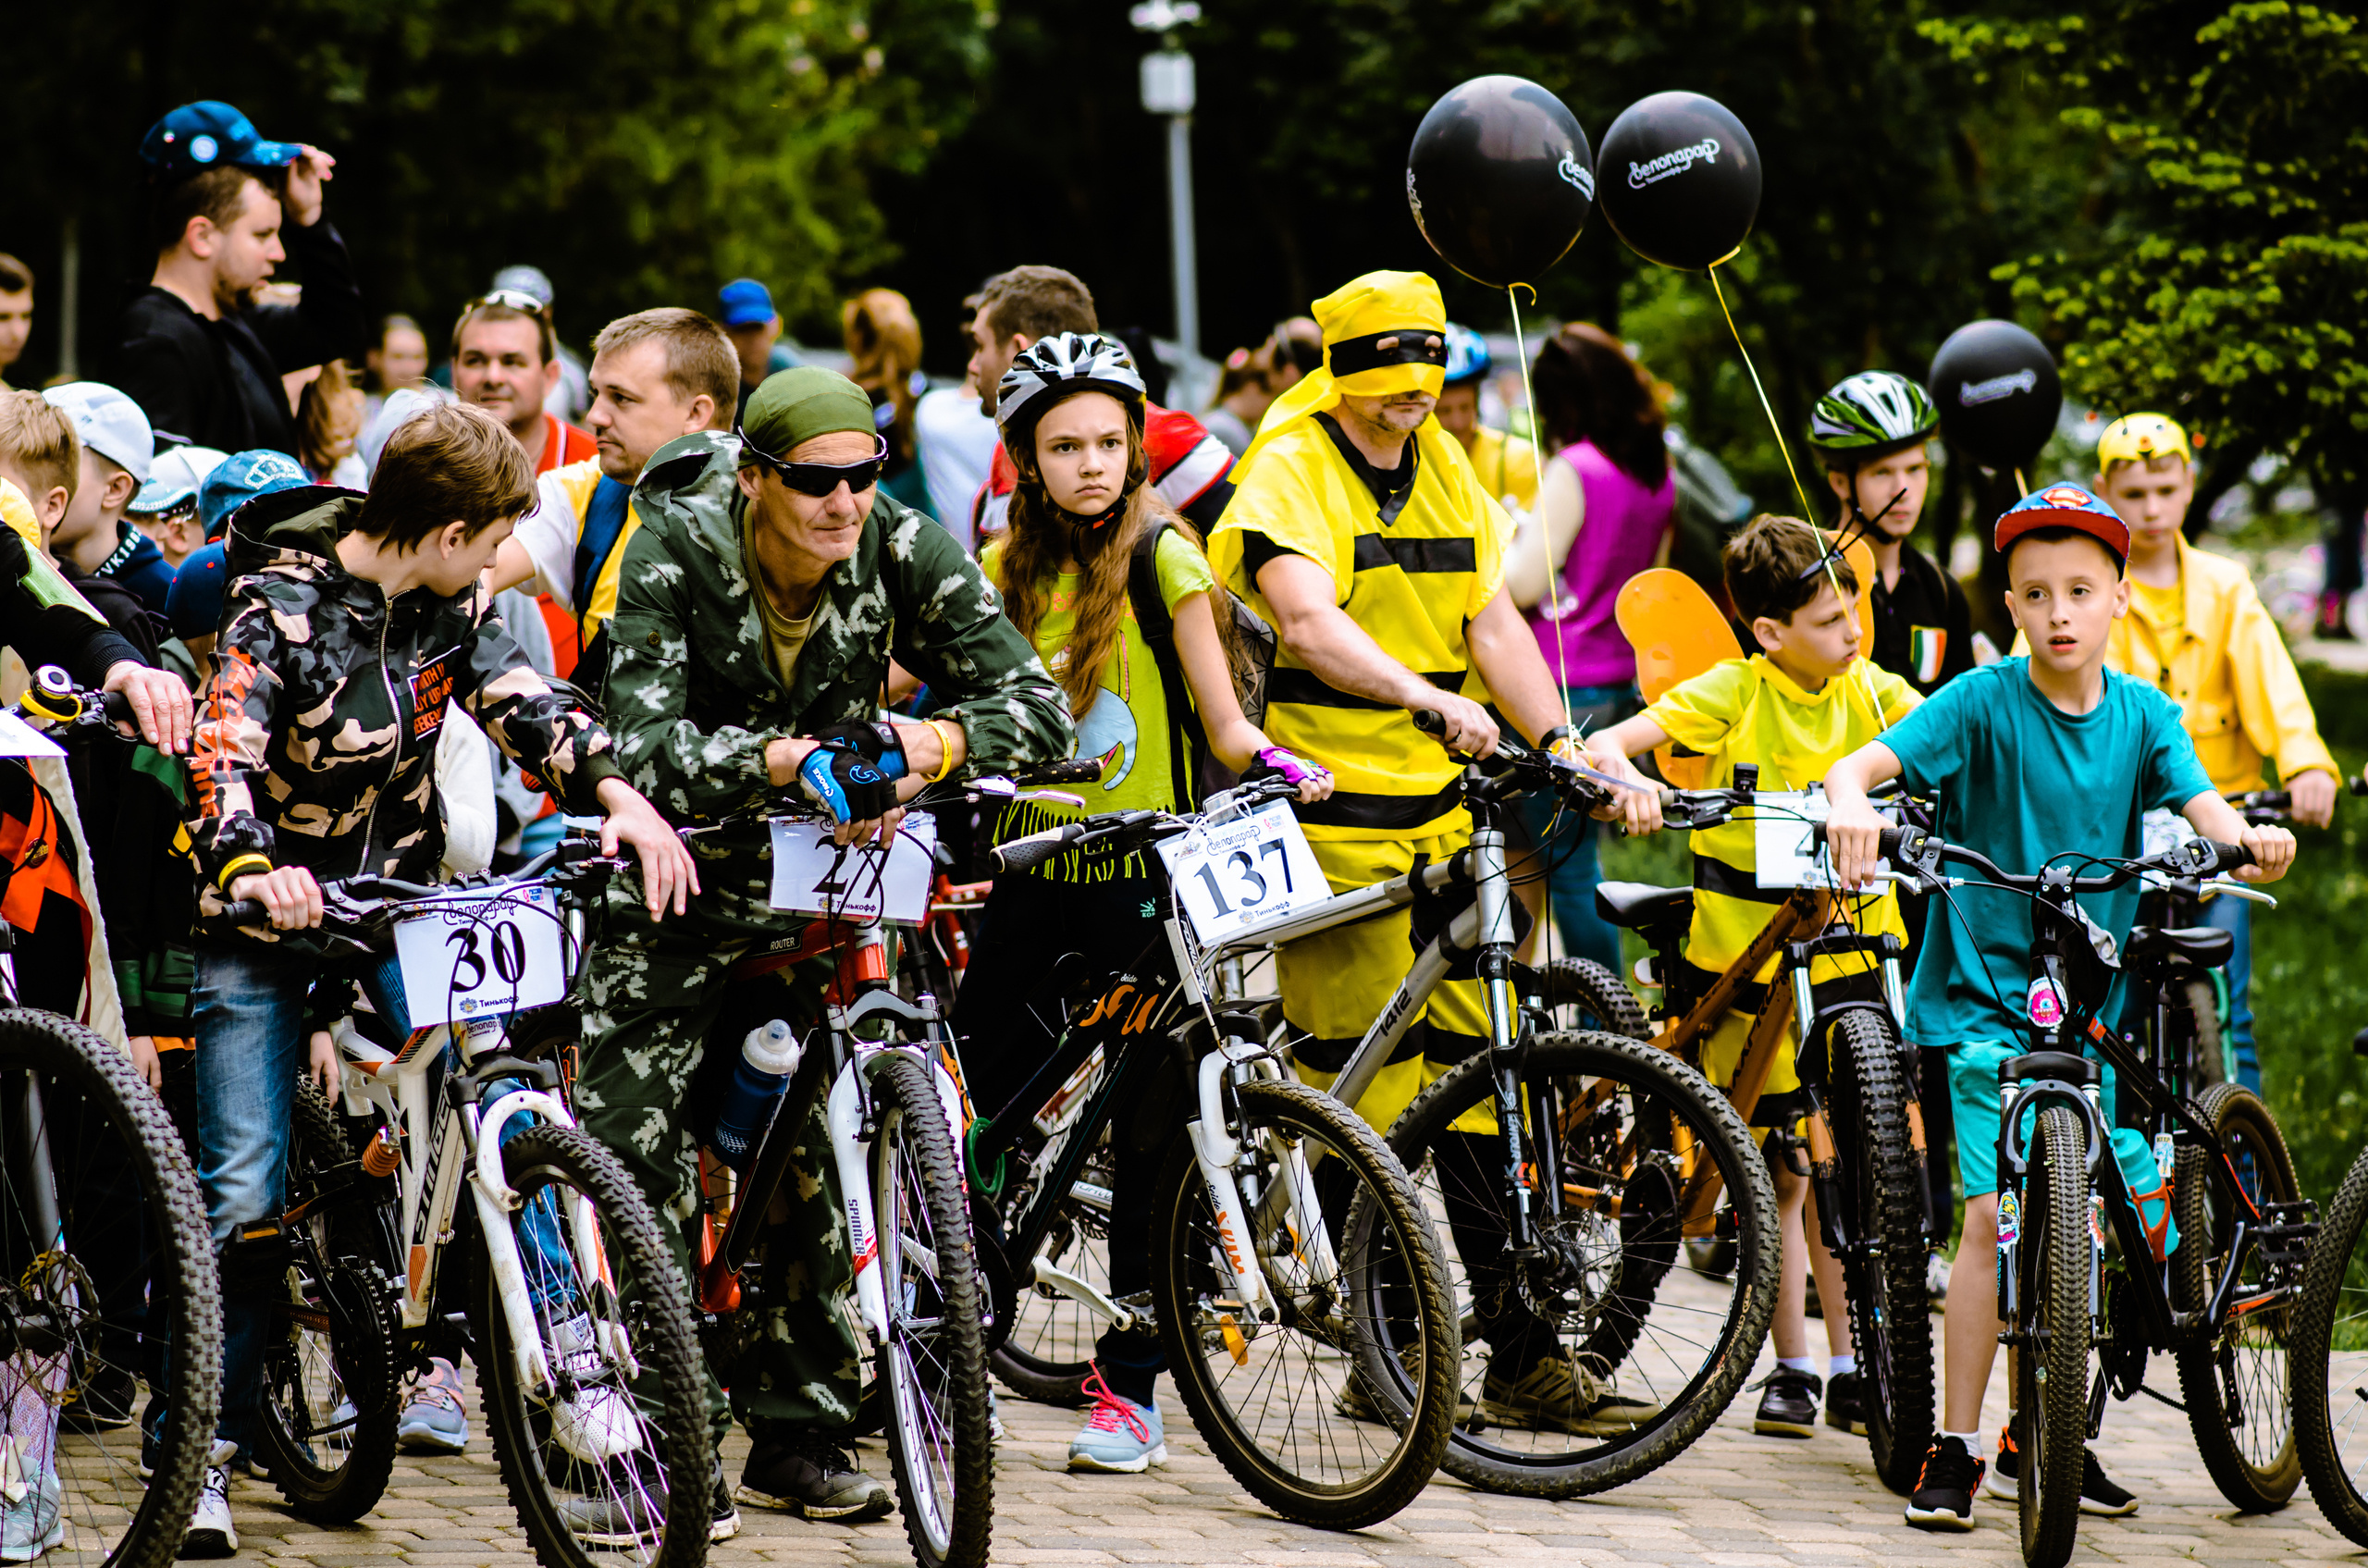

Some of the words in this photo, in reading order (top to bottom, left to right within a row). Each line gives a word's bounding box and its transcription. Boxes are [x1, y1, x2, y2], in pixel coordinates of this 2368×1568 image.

[1193, 837, 1293, 920] 137
[836, 900, 877, 913] Тнькофф
[1254, 901, 1290, 918] Тинькофф
[445, 920, 526, 993] 30
[771, 936, 795, 951] ROUTER
[1379, 987, 1412, 1037] 1412
[847, 1199, 866, 1254] SPINNER
